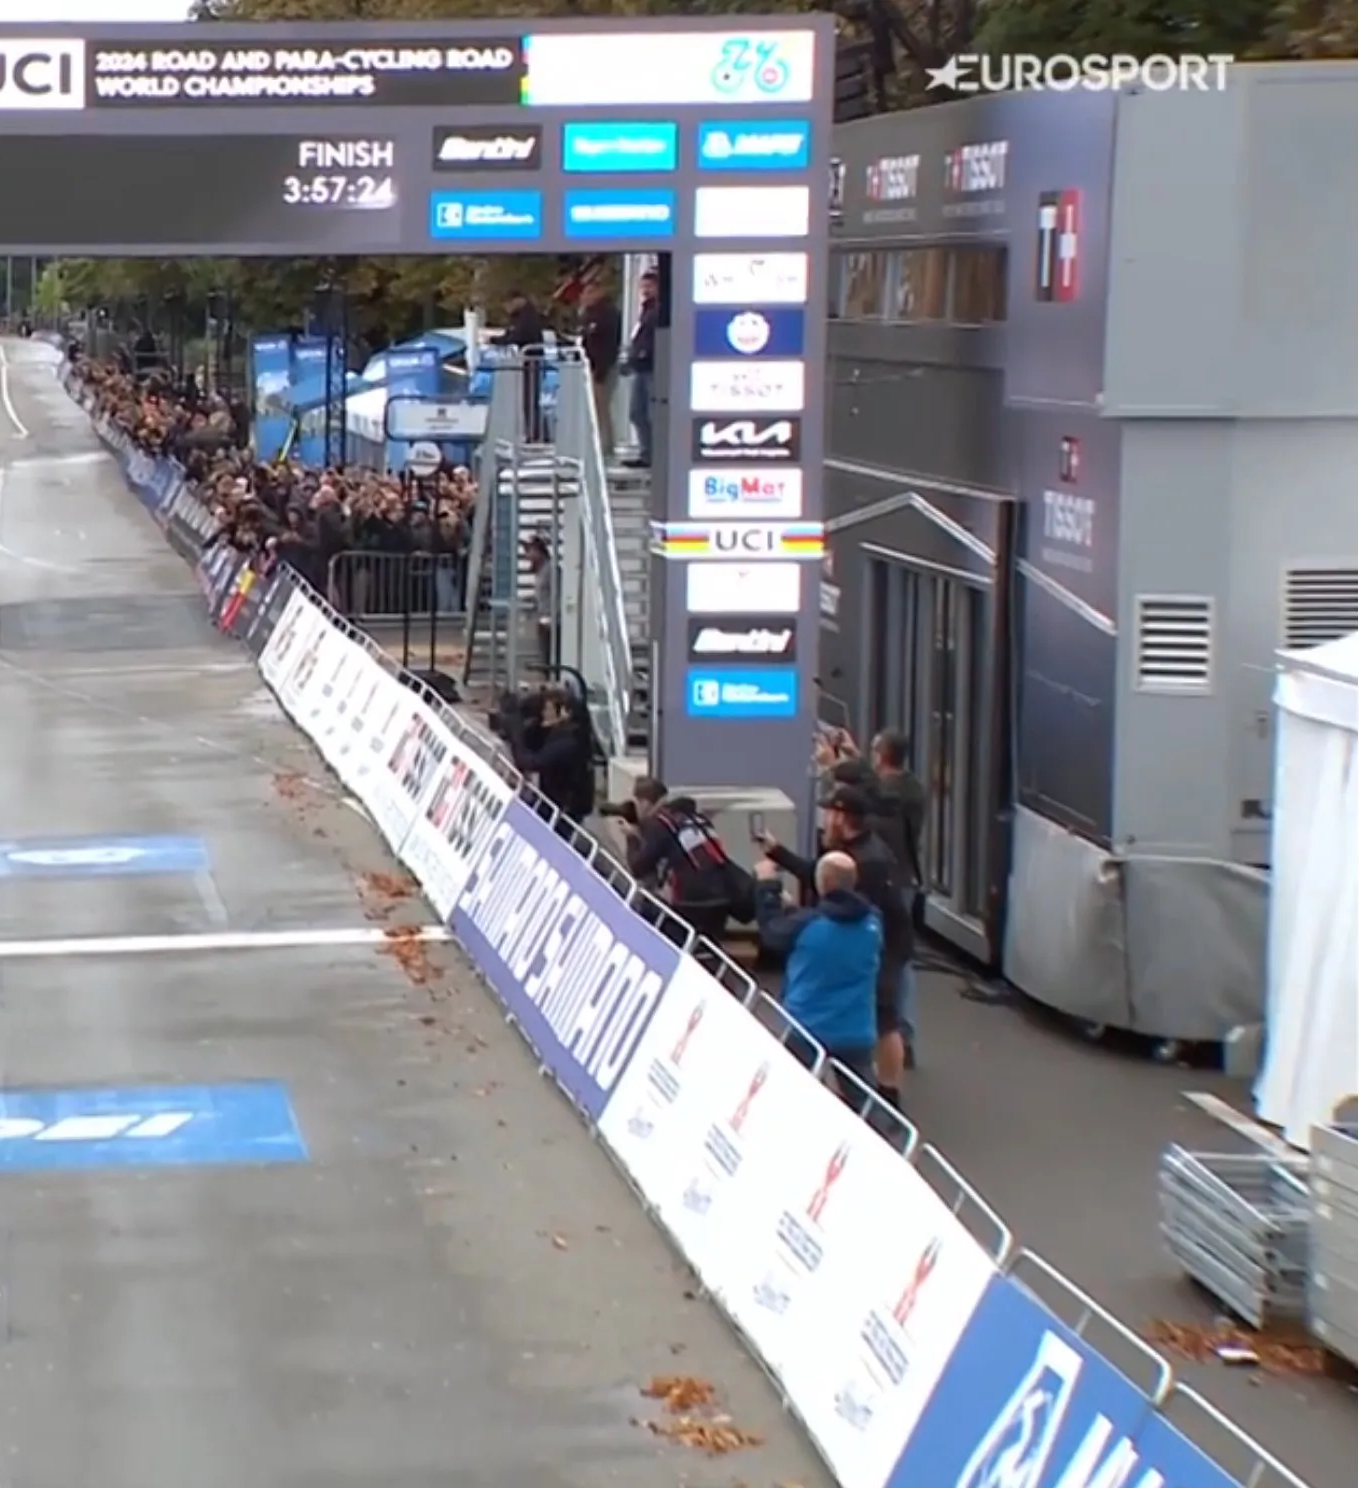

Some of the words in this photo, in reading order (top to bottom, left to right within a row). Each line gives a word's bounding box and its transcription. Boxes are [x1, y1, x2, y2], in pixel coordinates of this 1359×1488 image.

[95, 52, 147, 71] 2024
[151, 52, 217, 71] ROAD
[221, 51, 271, 71] AND
[274, 49, 442, 70] PARA-CYCLING
[446, 49, 514, 70] ROAD
[95, 76, 180, 96] WORLD
[184, 76, 376, 97] CHAMPIONSHIPS
[299, 141, 394, 167] FINISH
[282, 176, 395, 206] 3:57:24
[714, 529, 774, 551] UCI
[458, 822, 571, 984] SHIMANO
[525, 895, 664, 1092] SHIMANO
